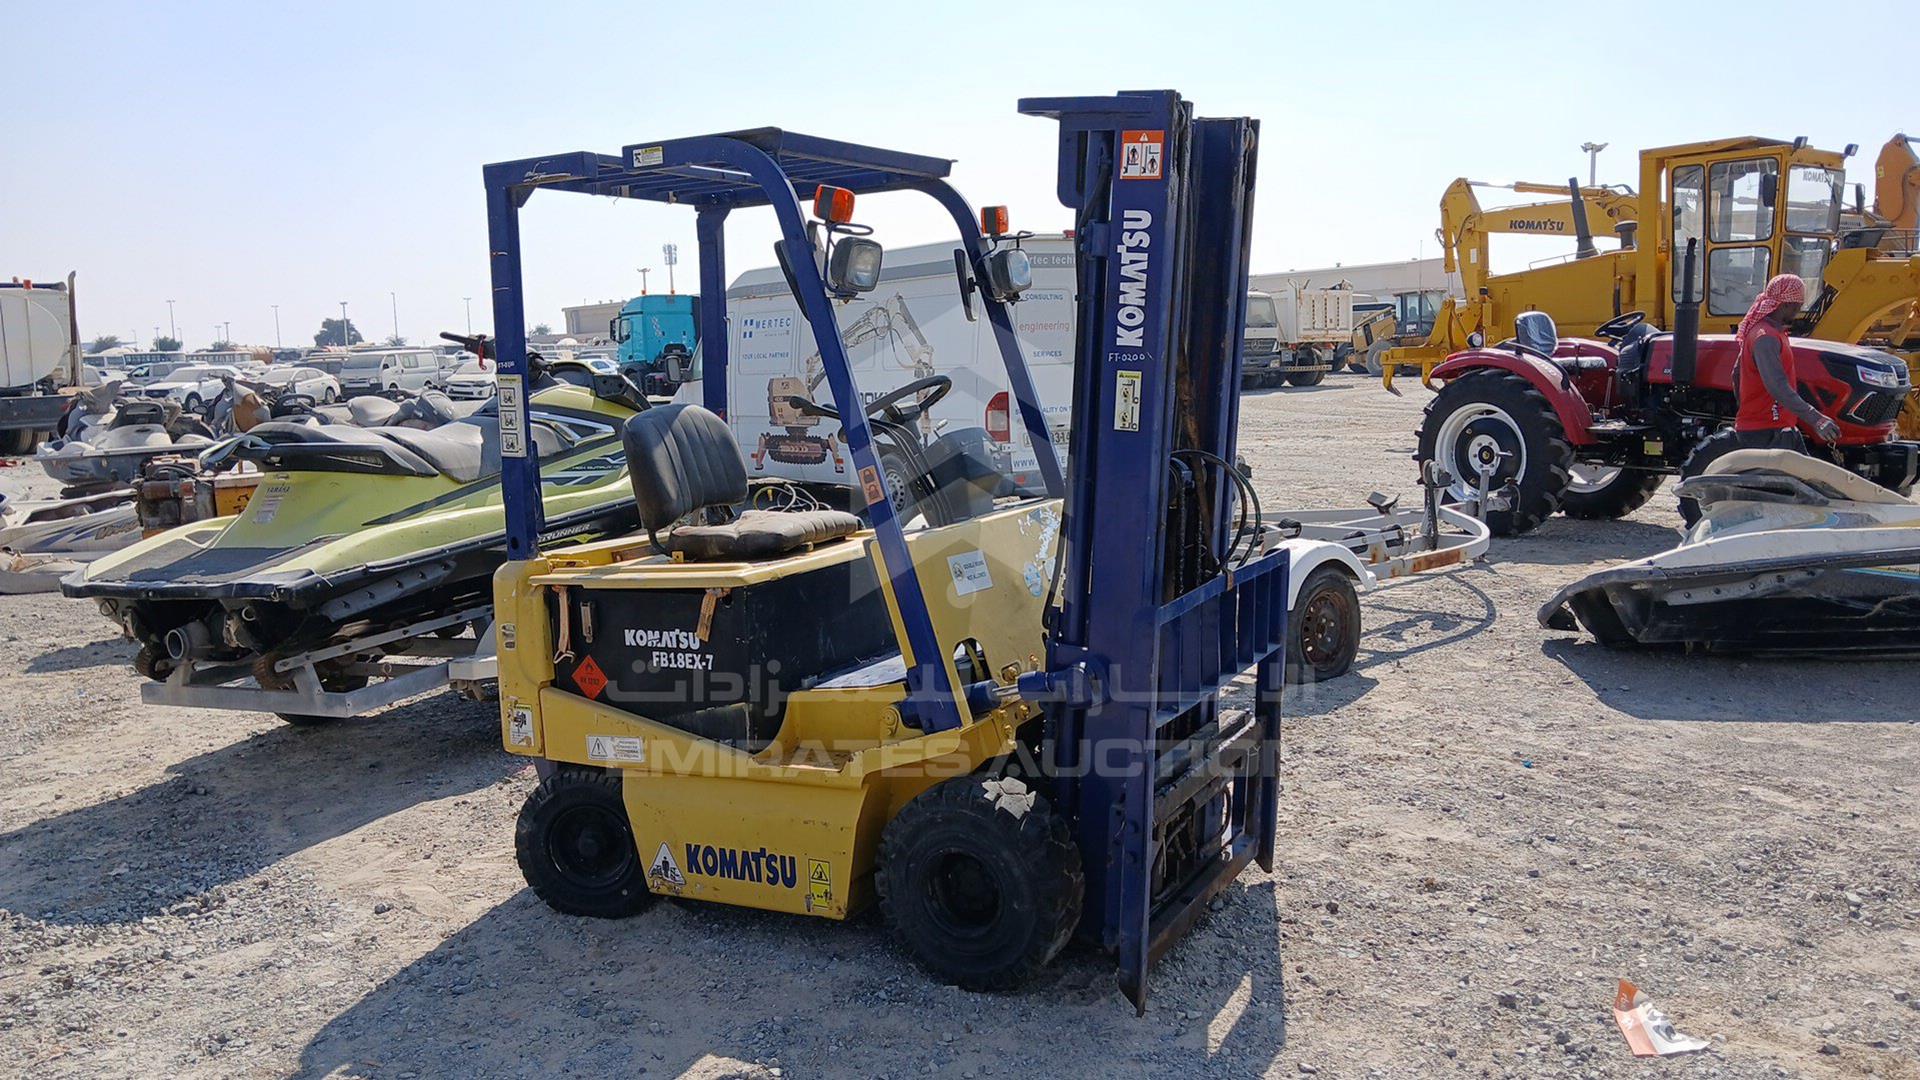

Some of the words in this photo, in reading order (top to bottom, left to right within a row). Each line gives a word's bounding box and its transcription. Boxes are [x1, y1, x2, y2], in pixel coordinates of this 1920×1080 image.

[1509, 218, 1565, 231] KOMATSU
[1116, 209, 1152, 347] KOMATSU
[1025, 293, 1064, 301] CONSULTING
[1018, 320, 1070, 333] engineering
[624, 629, 700, 650] KOMATSU
[652, 651, 713, 670] FB18EX-7
[685, 843, 797, 888] KOMATSU
